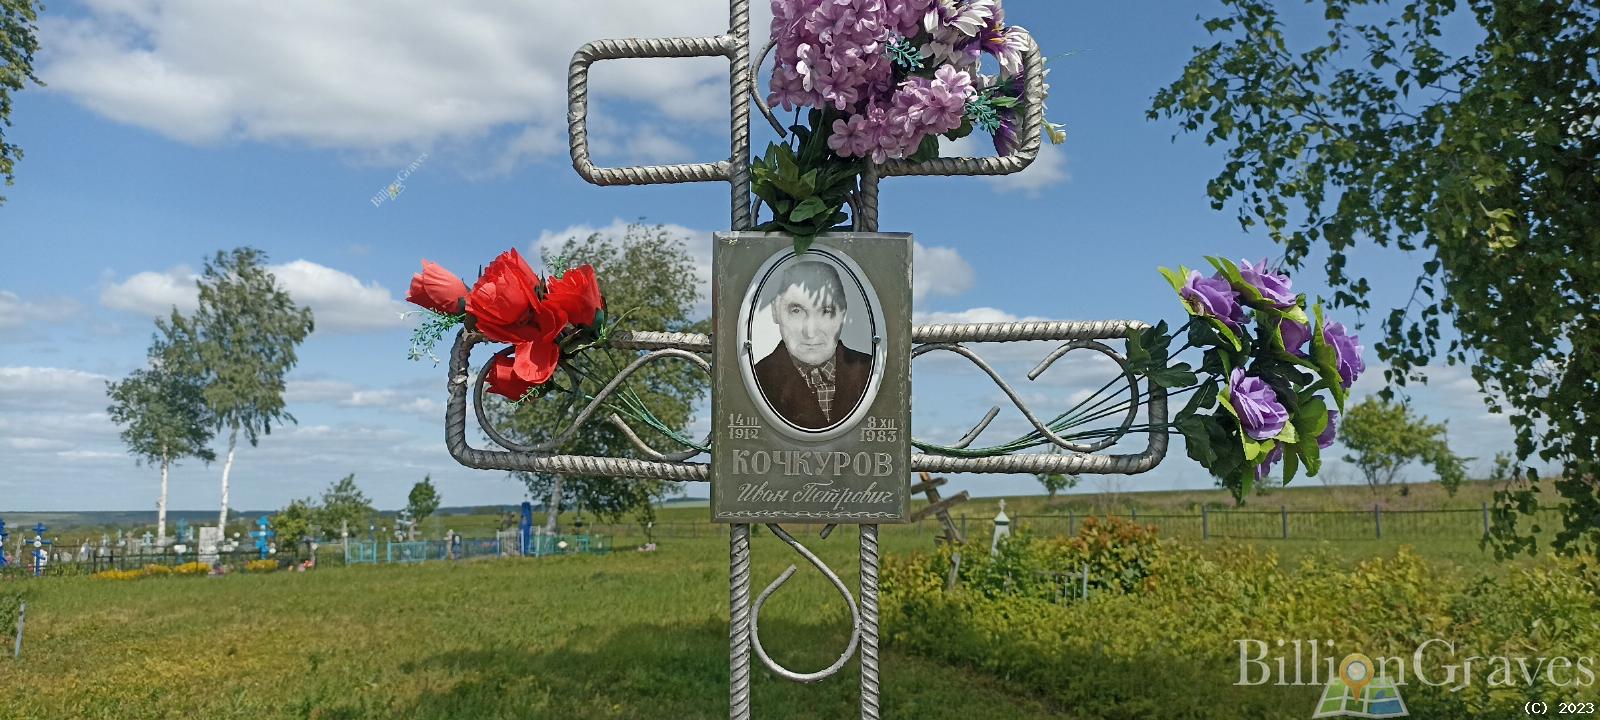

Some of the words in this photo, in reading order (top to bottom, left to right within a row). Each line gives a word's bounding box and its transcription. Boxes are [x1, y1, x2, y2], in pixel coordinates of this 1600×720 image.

[729, 413, 744, 426] 14
[880, 418, 895, 429] XII
[728, 427, 759, 440] 1912
[859, 428, 897, 442] 1983
[732, 449, 893, 477] КОЧКУРОВ
[737, 480, 789, 502] Иван
[792, 479, 895, 511] Петрович
